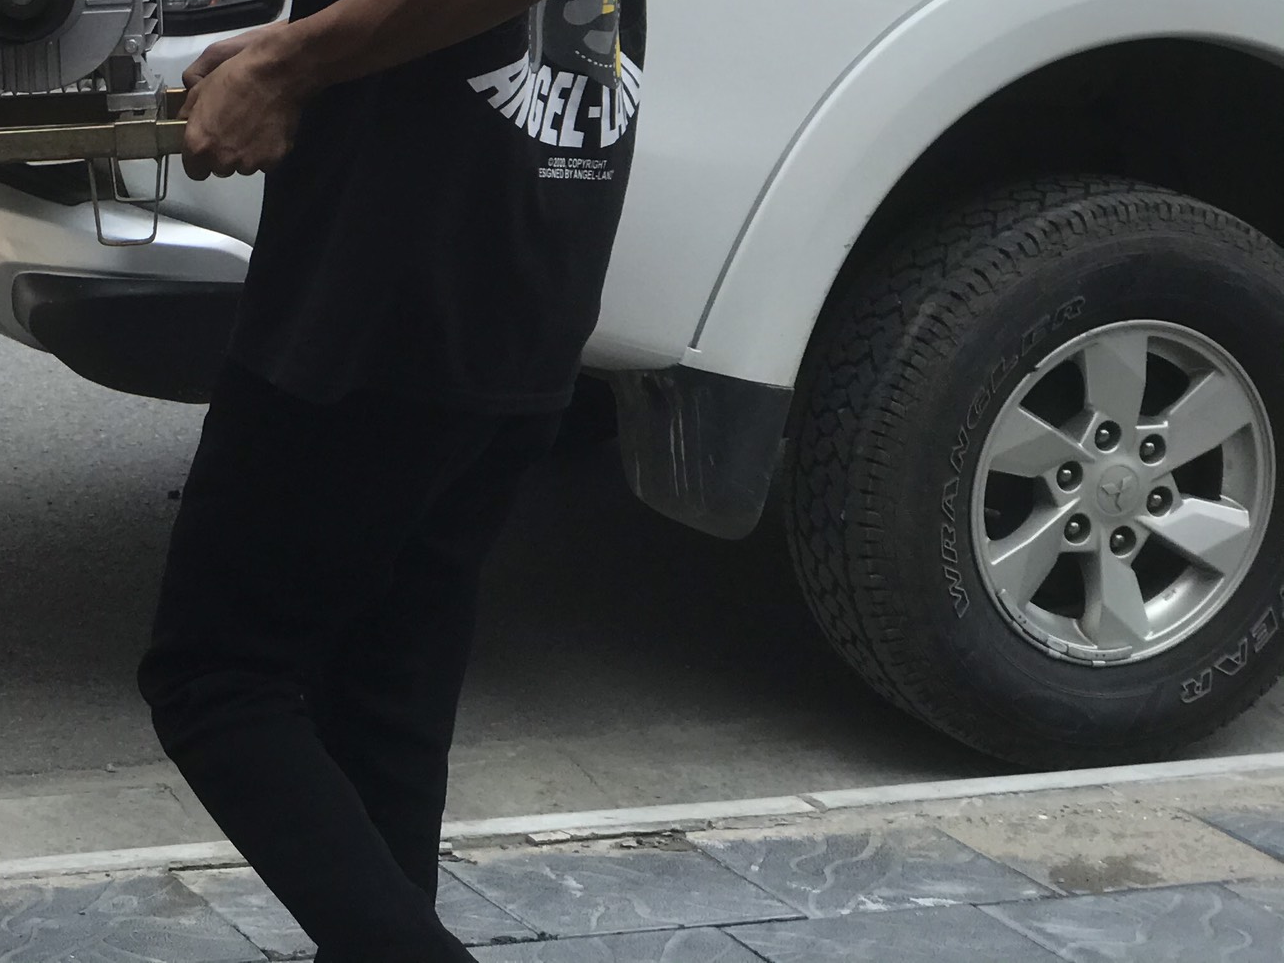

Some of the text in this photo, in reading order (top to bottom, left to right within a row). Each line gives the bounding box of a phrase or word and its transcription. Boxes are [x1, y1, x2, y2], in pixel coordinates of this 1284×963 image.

[567, 158, 607, 169] COPYRIGHT
[538, 167, 564, 179] ESIGNED
[940, 295, 1086, 619] WRANGLER
